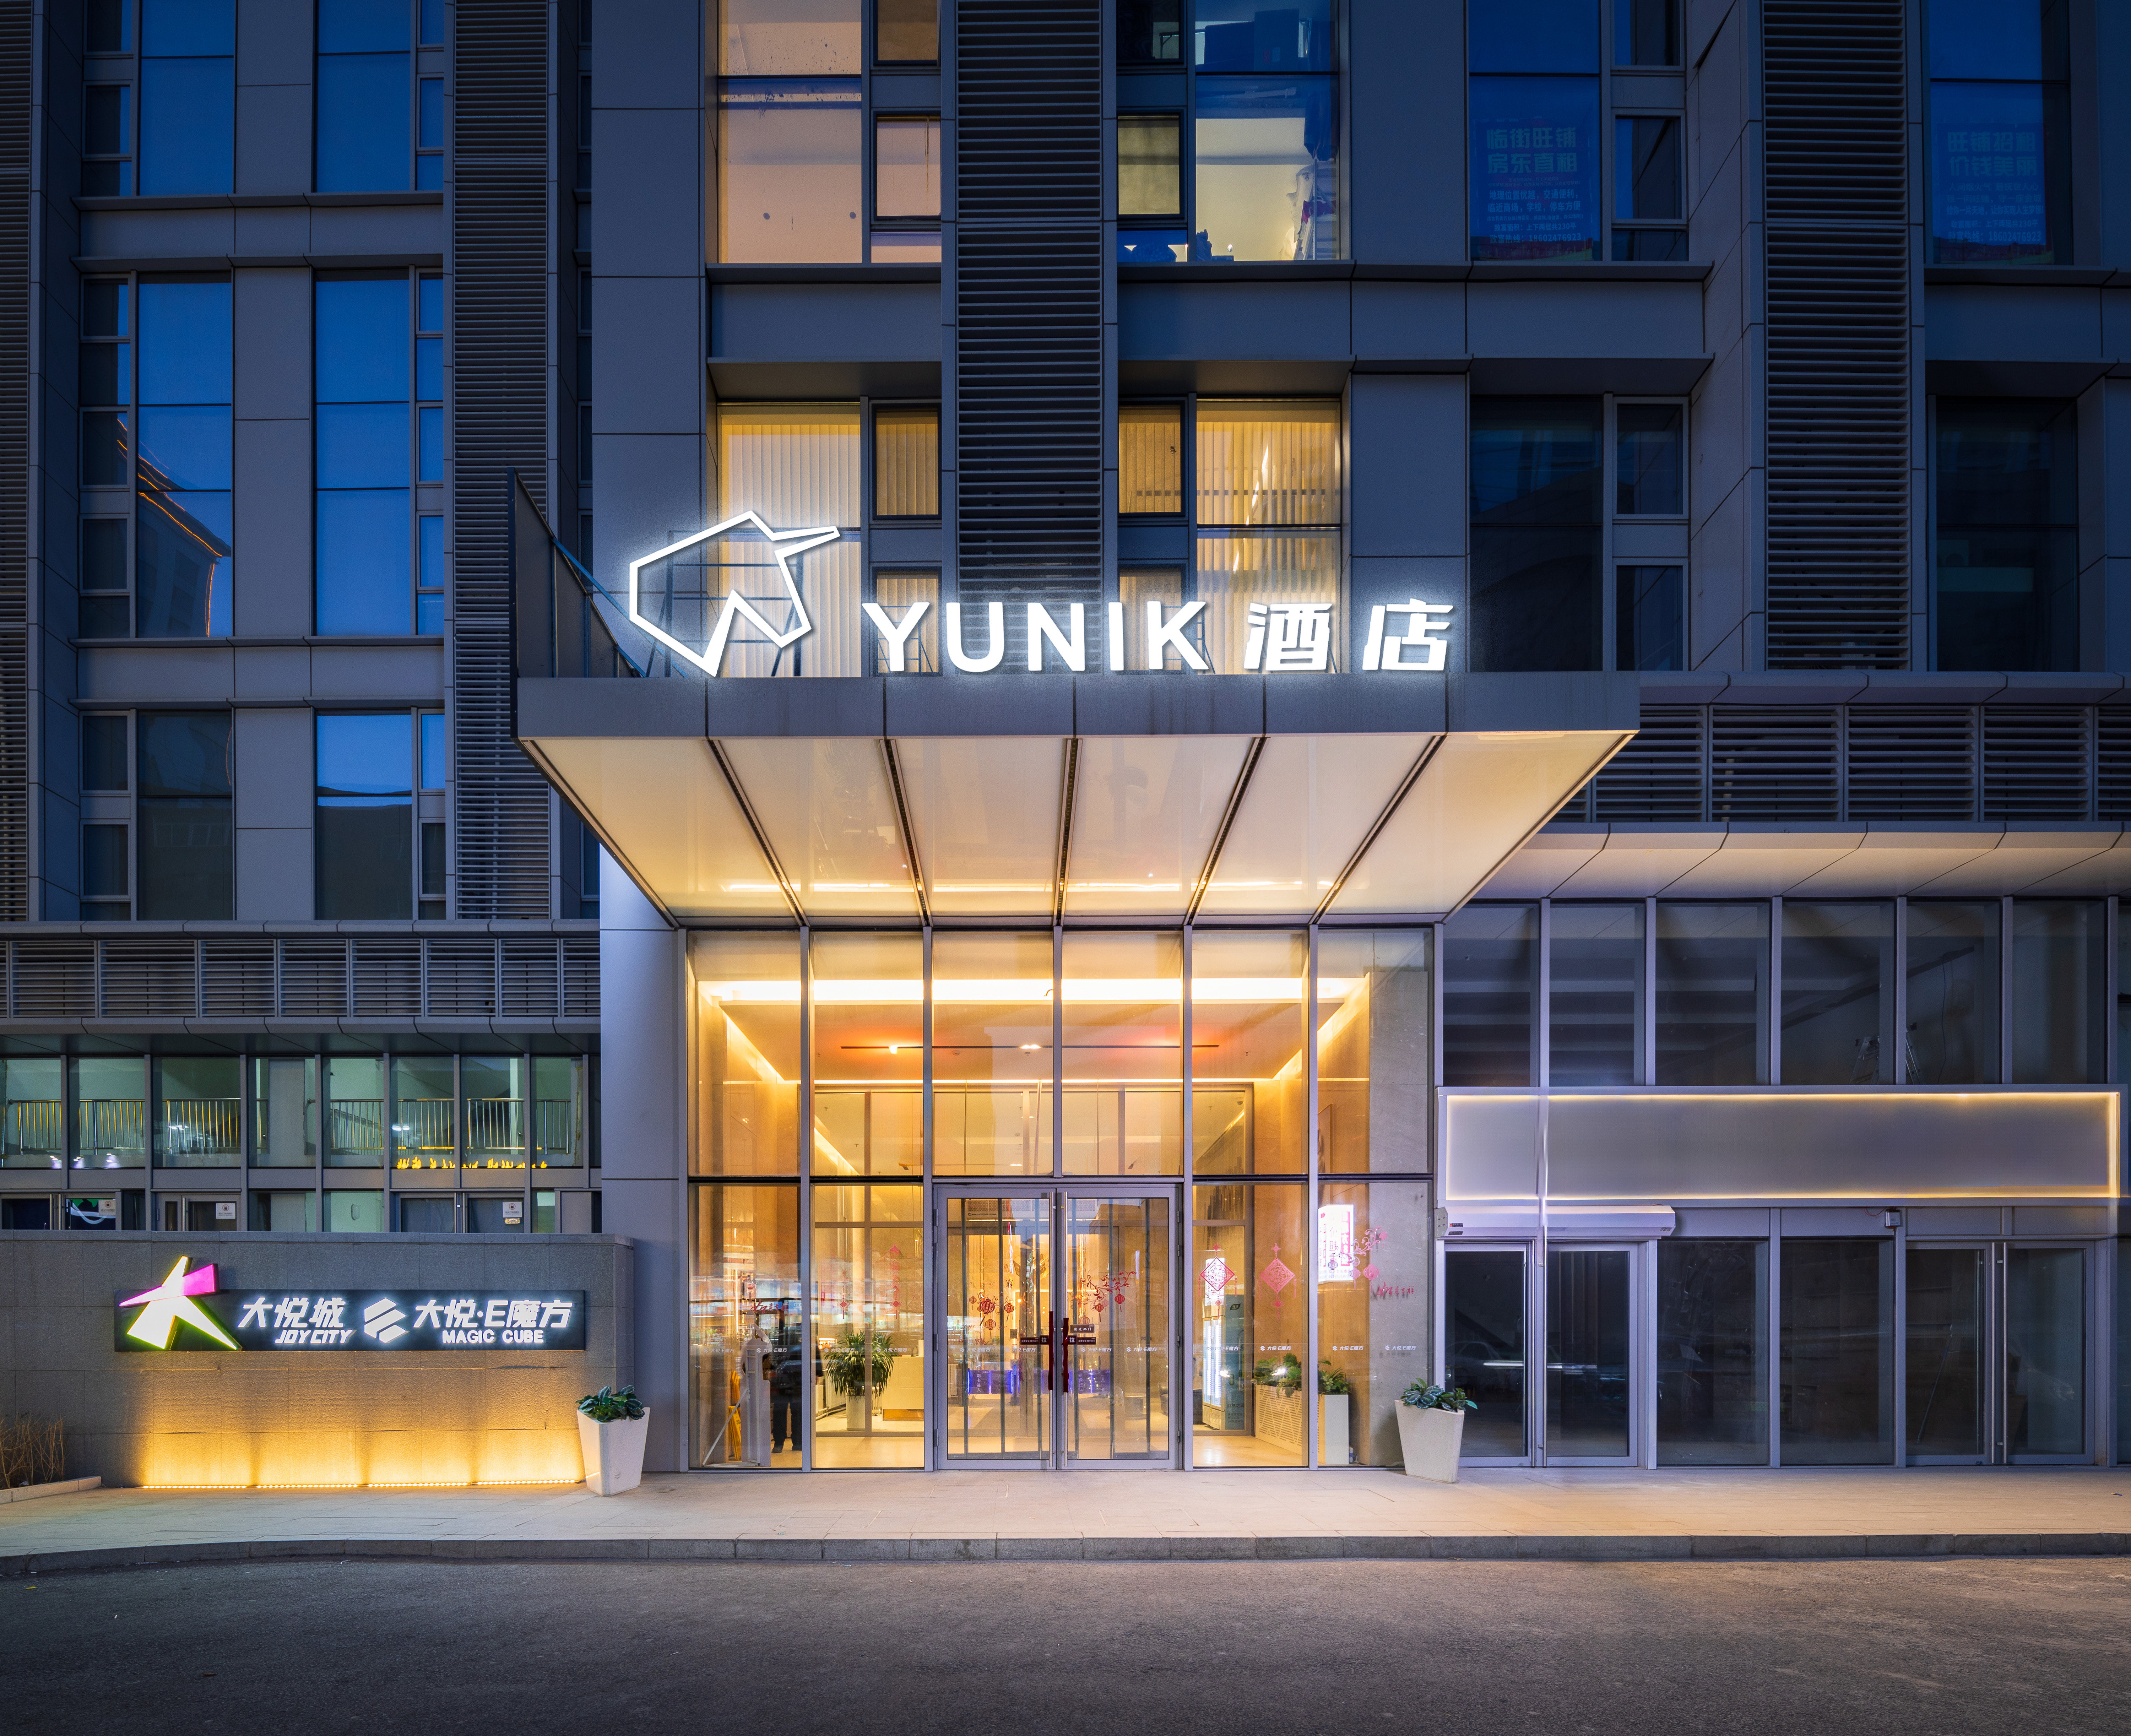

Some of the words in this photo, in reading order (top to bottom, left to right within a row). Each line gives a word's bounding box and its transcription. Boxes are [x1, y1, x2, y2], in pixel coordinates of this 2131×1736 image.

[1487, 127, 1576, 149] 临街旺铺
[1948, 131, 2035, 152] 旺铺招租
[1488, 152, 1577, 173] 房东直租
[1949, 156, 2037, 177] 价钱美丽
[861, 601, 1209, 672] YUNIK
[1243, 598, 1454, 671] 酒店
[238, 1297, 346, 1328] 大悦城
[413, 1299, 573, 1328] 大悦·E魔方
[443, 1330, 495, 1343] MAGIC
[502, 1330, 544, 1343] CUBE
